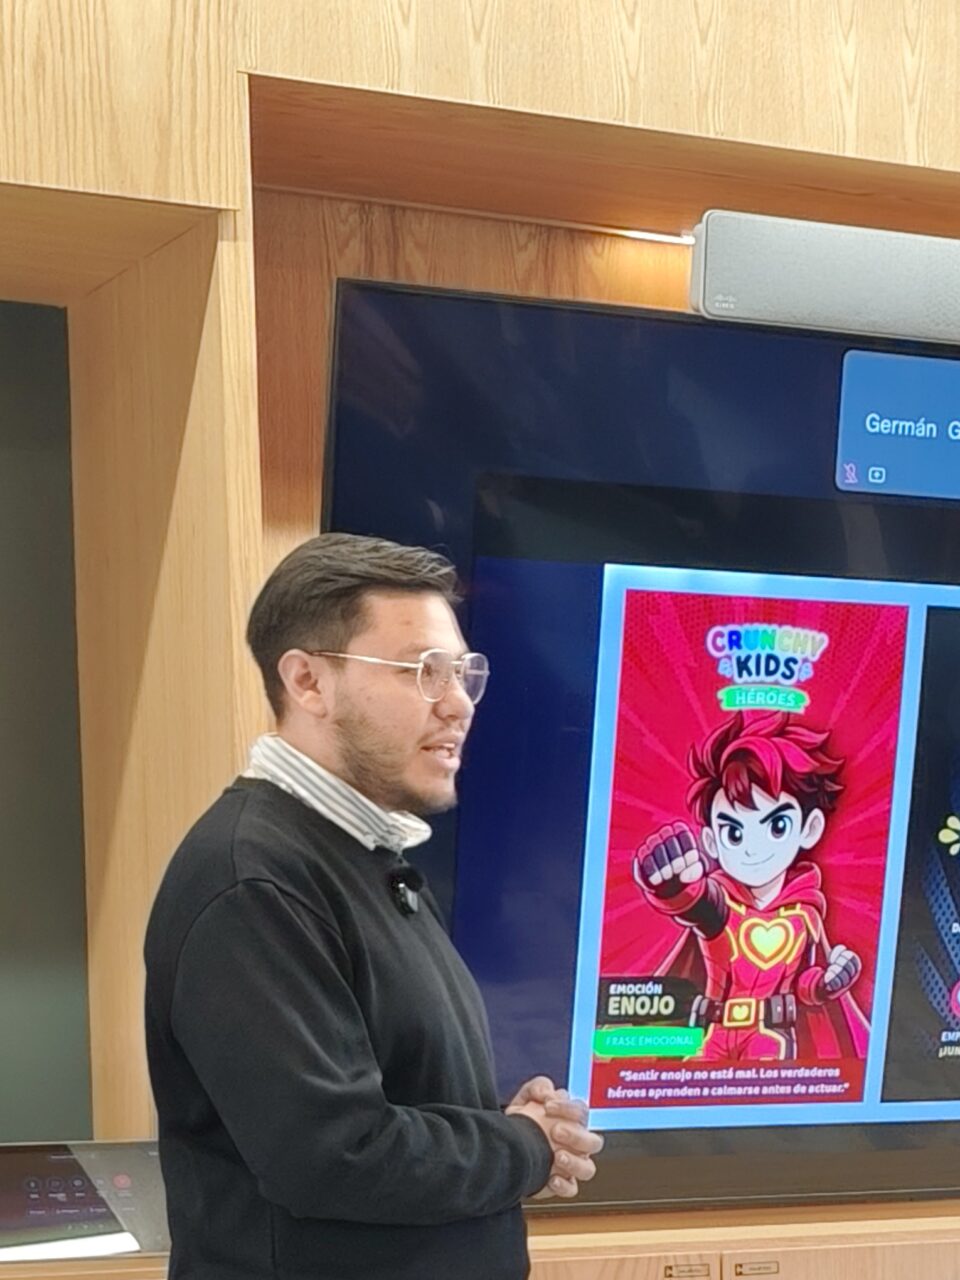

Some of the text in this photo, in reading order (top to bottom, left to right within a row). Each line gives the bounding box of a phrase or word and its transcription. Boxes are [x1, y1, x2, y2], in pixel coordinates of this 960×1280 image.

[865, 413, 938, 439] Germán
[709, 626, 828, 660] CRUNCHY
[735, 653, 799, 681] KIDS
[735, 687, 796, 707] HÉROES
[609, 981, 662, 996] EMOCIÓN
[608, 995, 675, 1016] ENOJO
[661, 1068, 692, 1083] enojo
[693, 1070, 708, 1081] no
[710, 1067, 734, 1080] está
[735, 1067, 758, 1079] mal.
[760, 1067, 778, 1078] Los
[780, 1066, 840, 1078] verdaderos
[607, 1086, 647, 1099] héroes
[648, 1085, 701, 1099] aprenden
[702, 1086, 709, 1096] a
[711, 1084, 760, 1096] calmarse
[761, 1084, 791, 1095] antes
[793, 1083, 806, 1094] de
